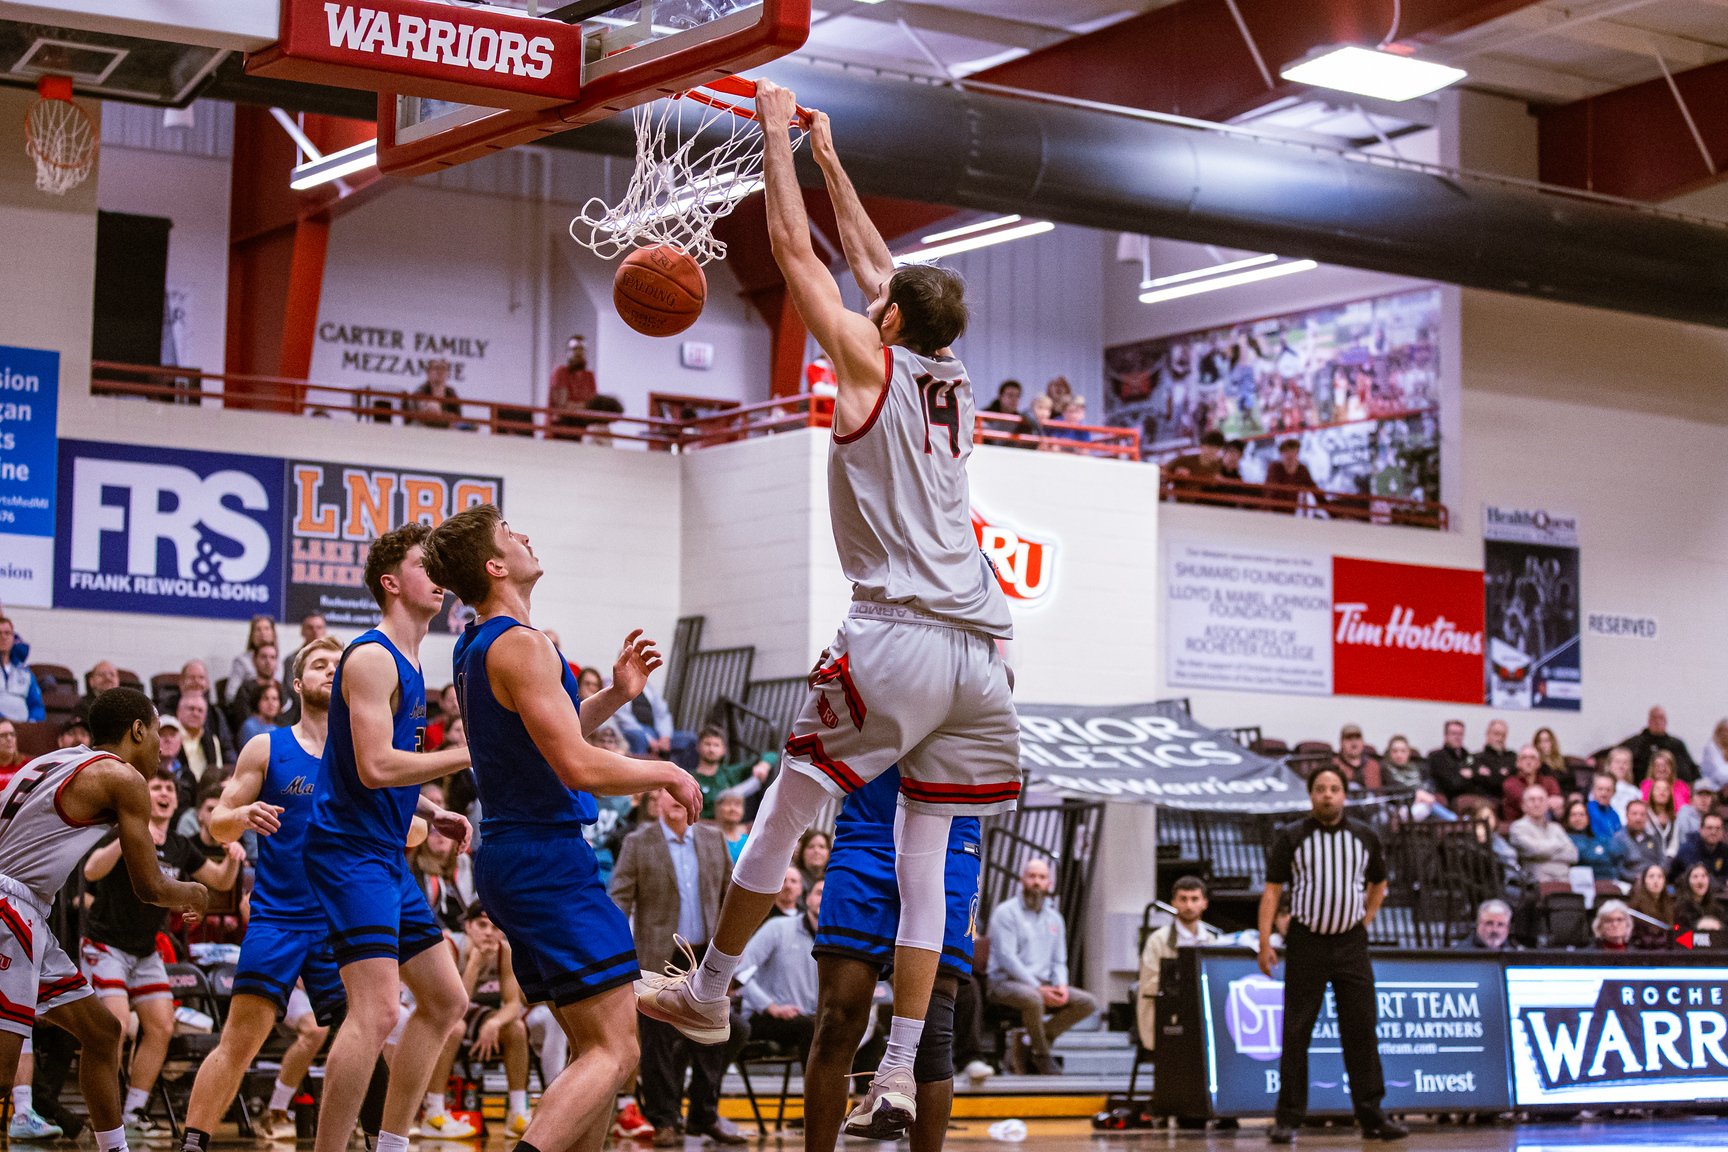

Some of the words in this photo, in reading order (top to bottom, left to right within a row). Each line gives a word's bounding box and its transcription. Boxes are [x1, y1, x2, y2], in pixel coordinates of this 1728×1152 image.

[324, 2, 555, 79] WARRIORS
[620, 271, 678, 307] SPALDING
[319, 322, 404, 349] CARTER
[414, 332, 489, 358] FAMILY
[916, 373, 962, 458] 14
[981, 526, 1055, 600] RU
[70, 572, 132, 594] FRANK
[1243, 568, 1324, 588] FOUNDATION
[1169, 584, 1211, 602] LLOYD
[1209, 601, 1292, 621] FOUNDATION
[1334, 602, 1382, 647] Tim
[1384, 604, 1483, 655] Hortons
[1588, 613, 1657, 638] RESERVED
[1261, 644, 1314, 661] COLLEGE
[823, 707, 838, 728] RU
[281, 775, 314, 795] Ma
[1411, 992, 1481, 1018] TEAM
[1621, 986, 1723, 1006] ROCHE
[1405, 1021, 1484, 1039] PARTNERS
[1526, 1009, 1728, 1083] WARR
[1414, 1068, 1477, 1093] Invest
